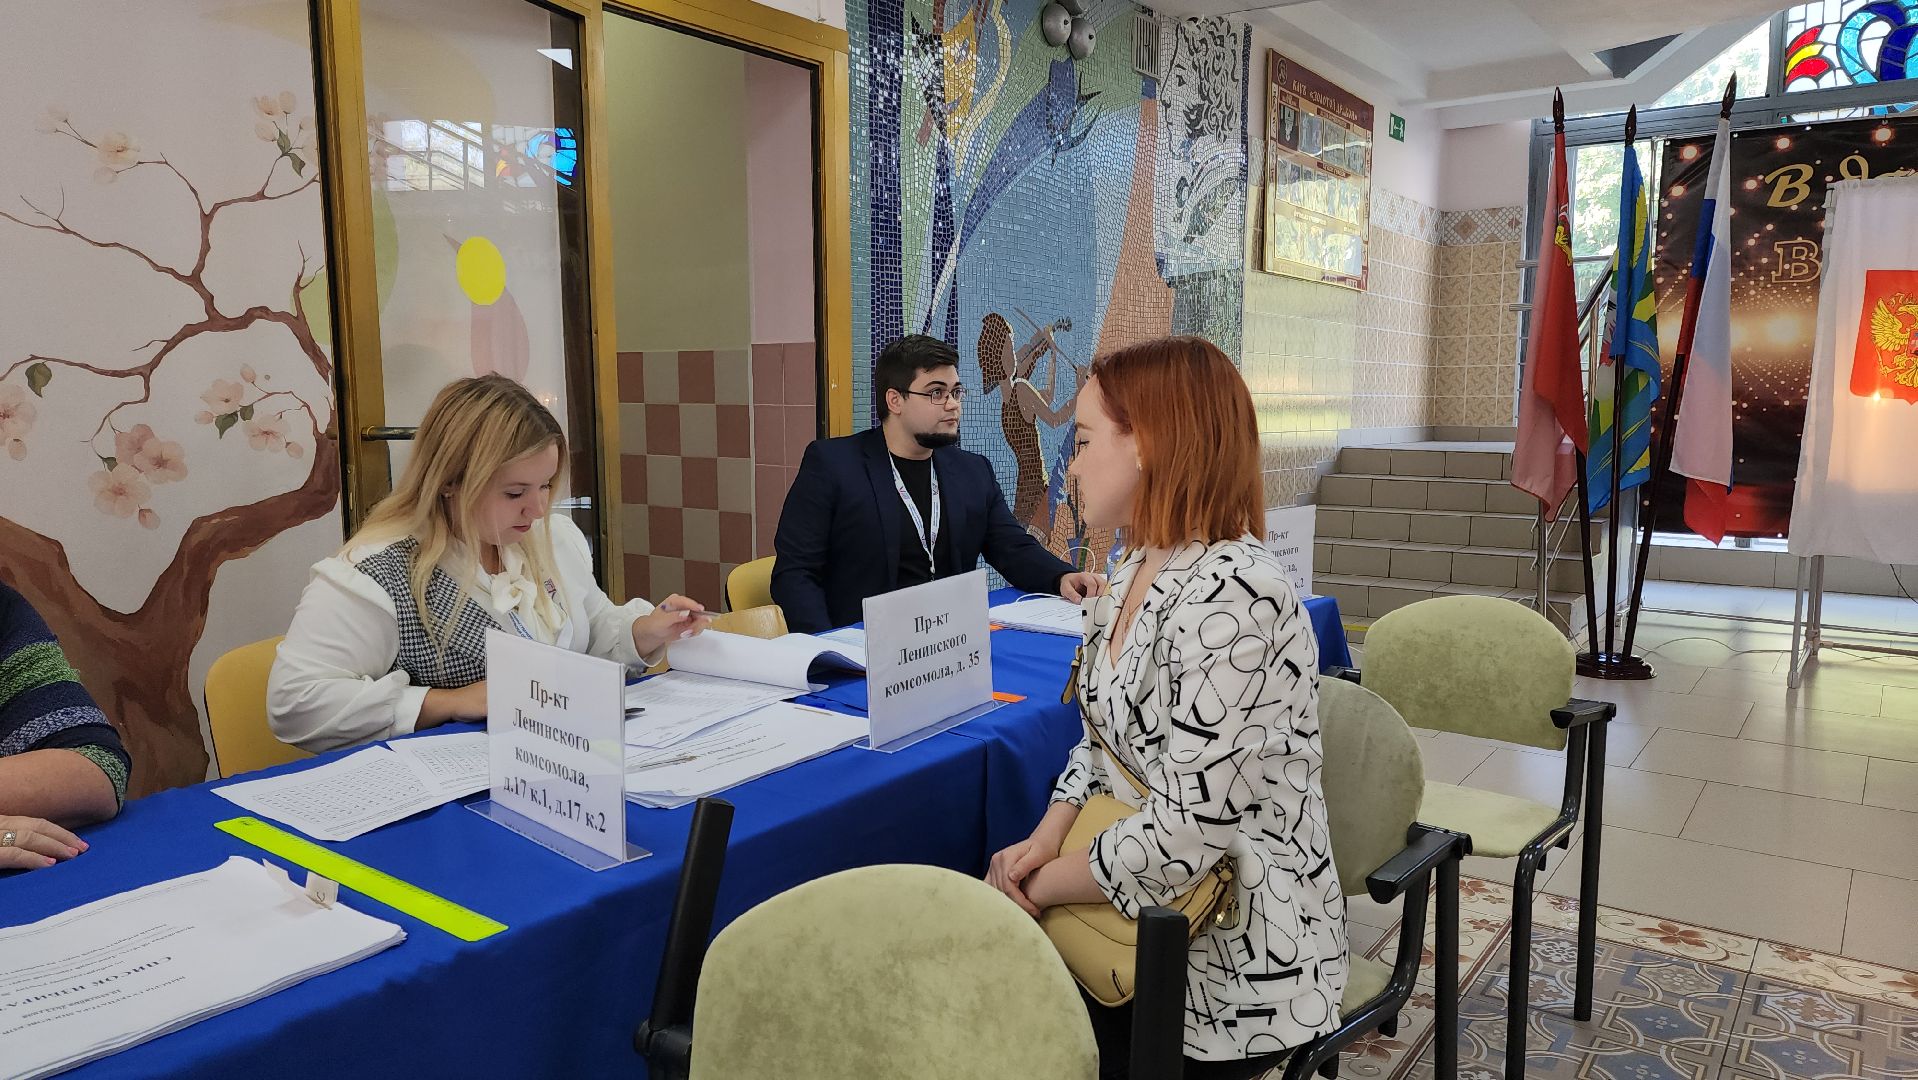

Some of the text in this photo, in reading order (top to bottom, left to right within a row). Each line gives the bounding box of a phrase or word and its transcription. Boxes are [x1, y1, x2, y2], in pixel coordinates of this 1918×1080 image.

[1765, 163, 1814, 208] В
[914, 612, 949, 634] Пр-кт
[898, 633, 967, 666] Ленинского
[530, 679, 570, 710] Пр-кт
[884, 649, 980, 698] комсомола, д. 35
[512, 707, 590, 753] Ленинского
[515, 746, 590, 793] комсомола,
[504, 776, 607, 834] д.17 к.1, д.17 к.2
